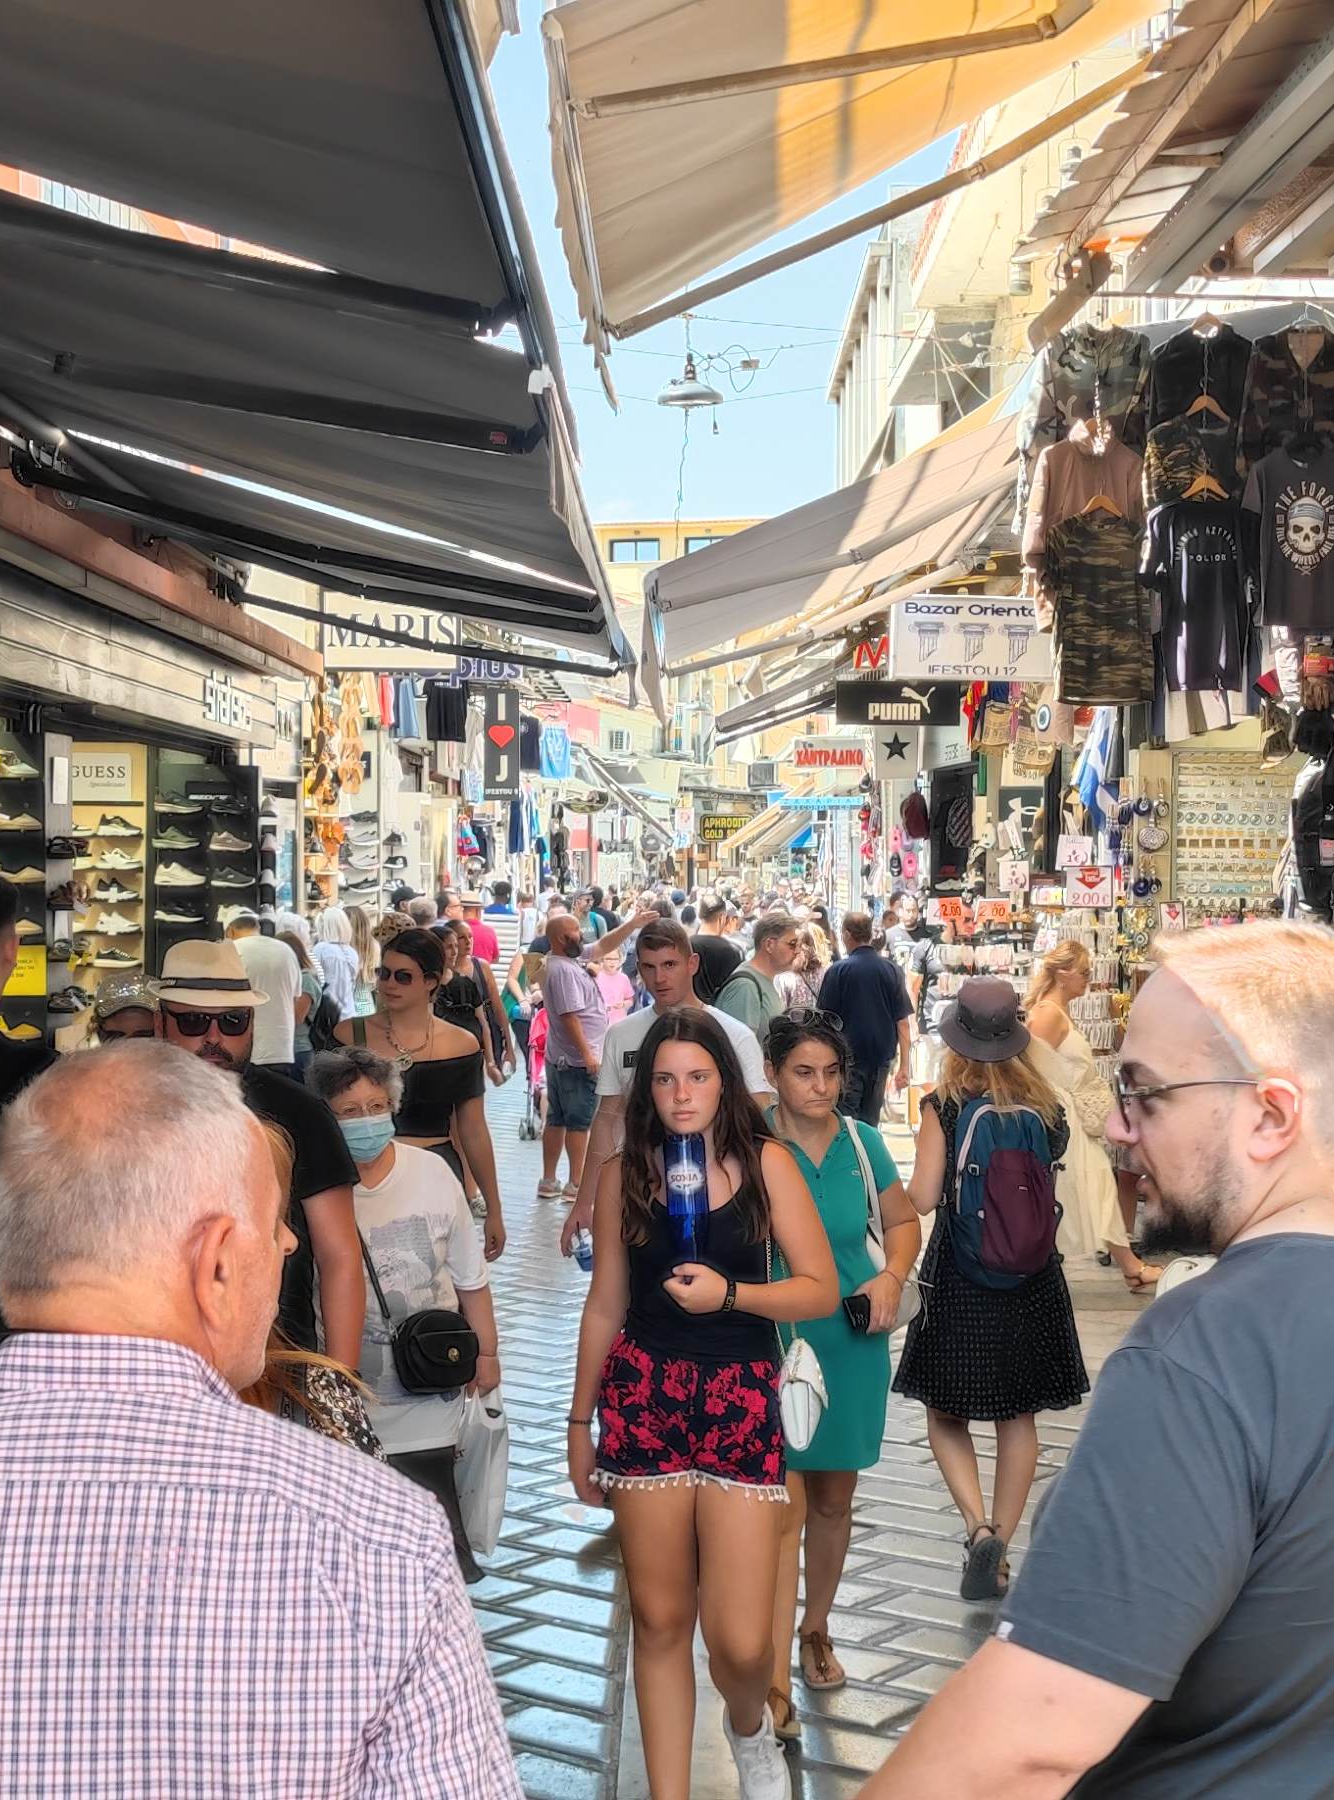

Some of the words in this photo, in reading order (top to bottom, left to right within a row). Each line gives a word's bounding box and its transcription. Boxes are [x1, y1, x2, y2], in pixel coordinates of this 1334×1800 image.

[1275, 485, 1297, 511] THE
[1189, 553, 1227, 562] POLICE
[1280, 541, 1292, 559] THE
[1291, 552, 1321, 566] WHEELS
[1319, 541, 1334, 559] FALL
[904, 602, 963, 616] Bazar
[968, 604, 1036, 618] Orienta
[928, 665, 998, 676] IFESTOU
[1003, 667, 1017, 676] 12
[868, 703, 921, 721] PUMA
[72, 765, 126, 779] GUESS
[704, 829, 724, 840] GOLD
[1072, 892, 1100, 906] 2.00
